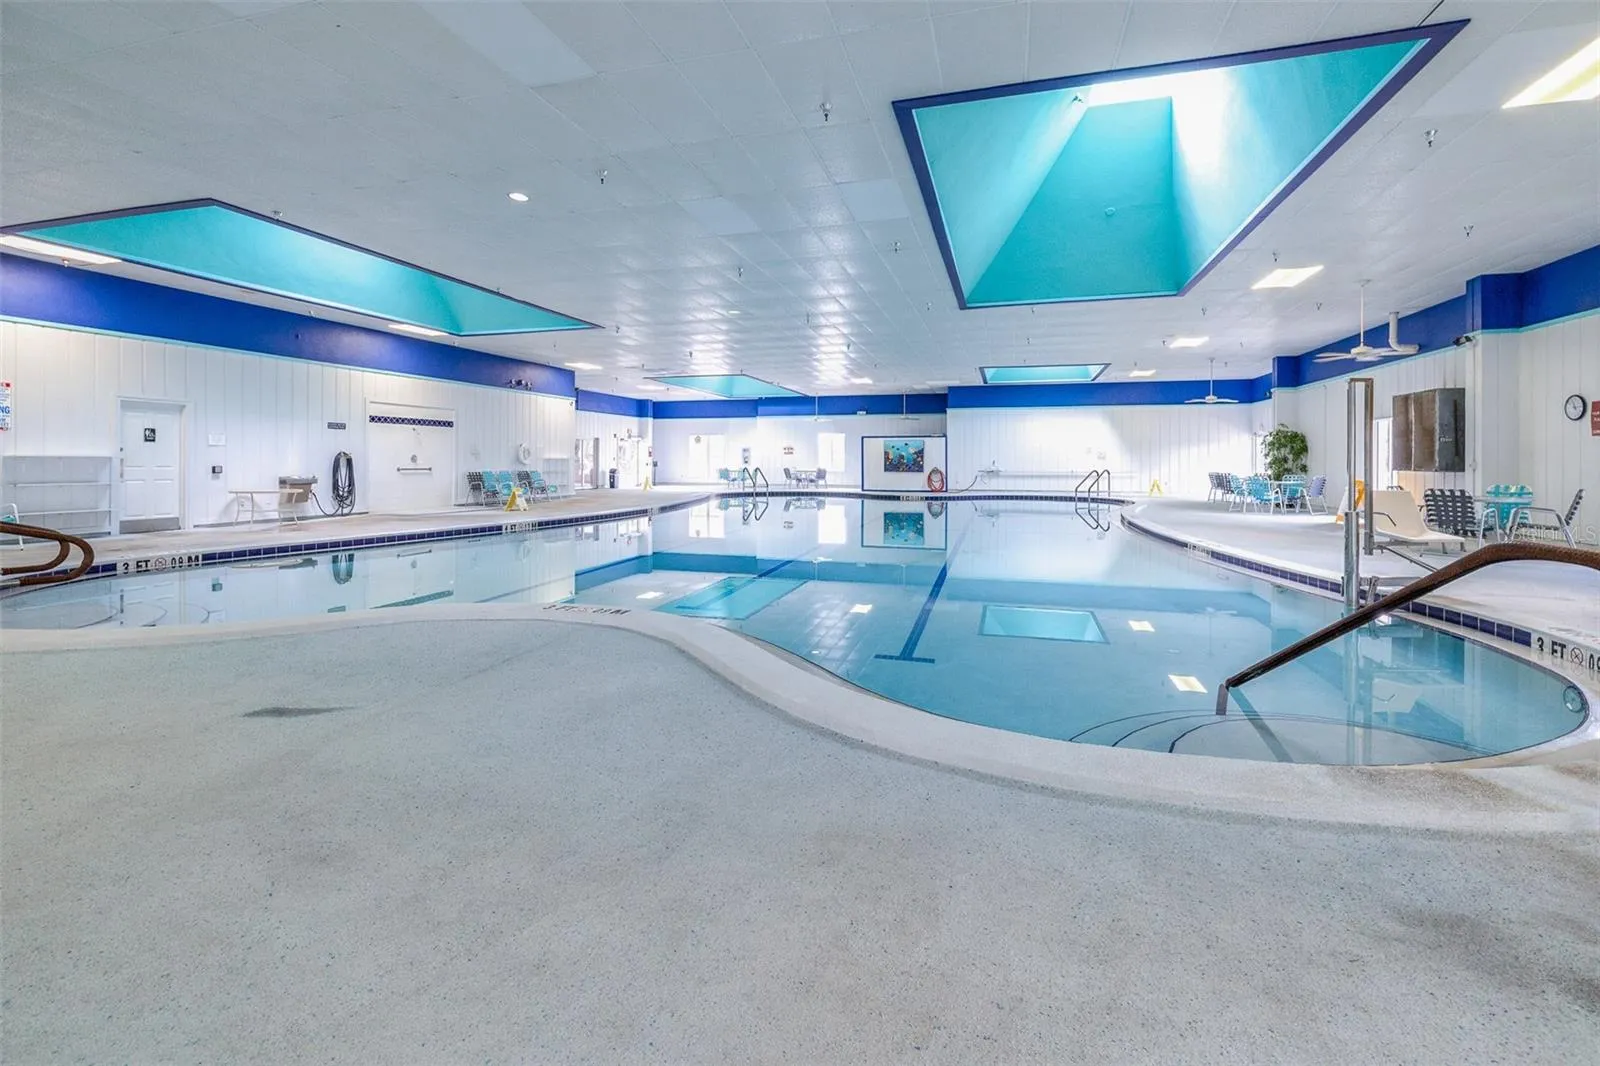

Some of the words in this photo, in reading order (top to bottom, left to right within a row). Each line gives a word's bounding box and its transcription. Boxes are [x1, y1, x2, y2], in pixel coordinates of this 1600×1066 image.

[122, 562, 130, 573] 3
[136, 559, 151, 571] FT
[1536, 636, 1545, 652] 3
[1551, 640, 1567, 659] FT
